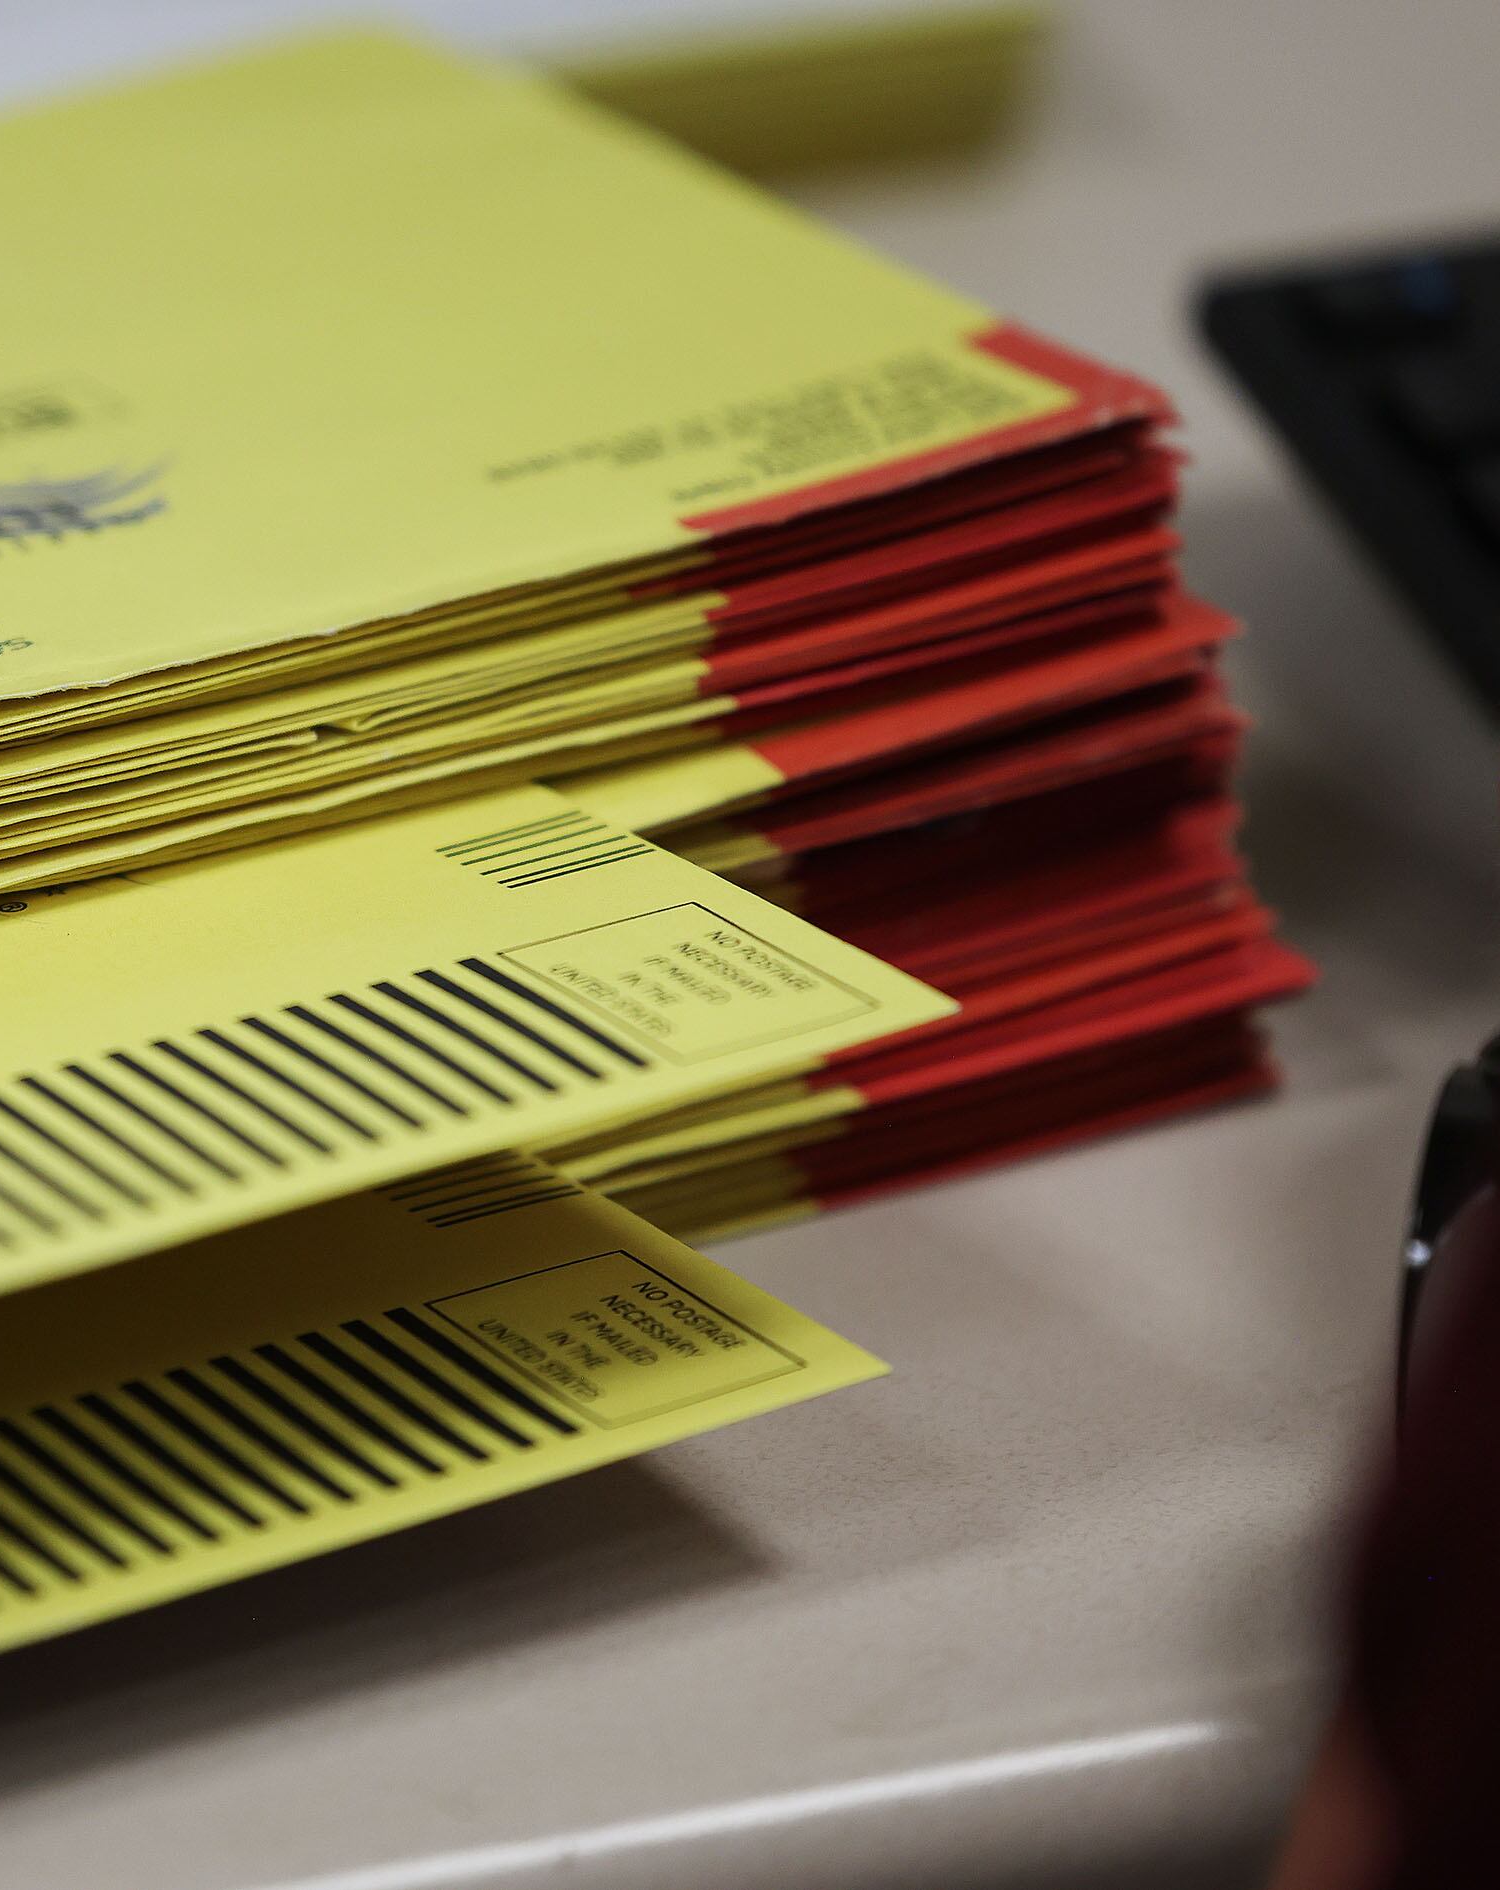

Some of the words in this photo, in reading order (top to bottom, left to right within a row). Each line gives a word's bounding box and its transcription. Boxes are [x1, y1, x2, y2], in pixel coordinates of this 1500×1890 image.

[550, 962, 620, 1000] UNITED
[667, 964, 732, 1005] MAILED
[672, 941, 775, 998] NECESSARY
[704, 928, 742, 949] NO
[739, 944, 817, 992] POSTAGE
[570, 1310, 599, 1323] IF
[586, 1321, 659, 1367] MAILED
[600, 1294, 703, 1358] NECESSARY
[631, 1281, 669, 1301] NO
[660, 1299, 746, 1350] POSTAGE
[477, 1318, 548, 1364] UNITED
[538, 1358, 606, 1400] STATES
[547, 1329, 576, 1348] IN
[577, 1343, 612, 1370] THE
